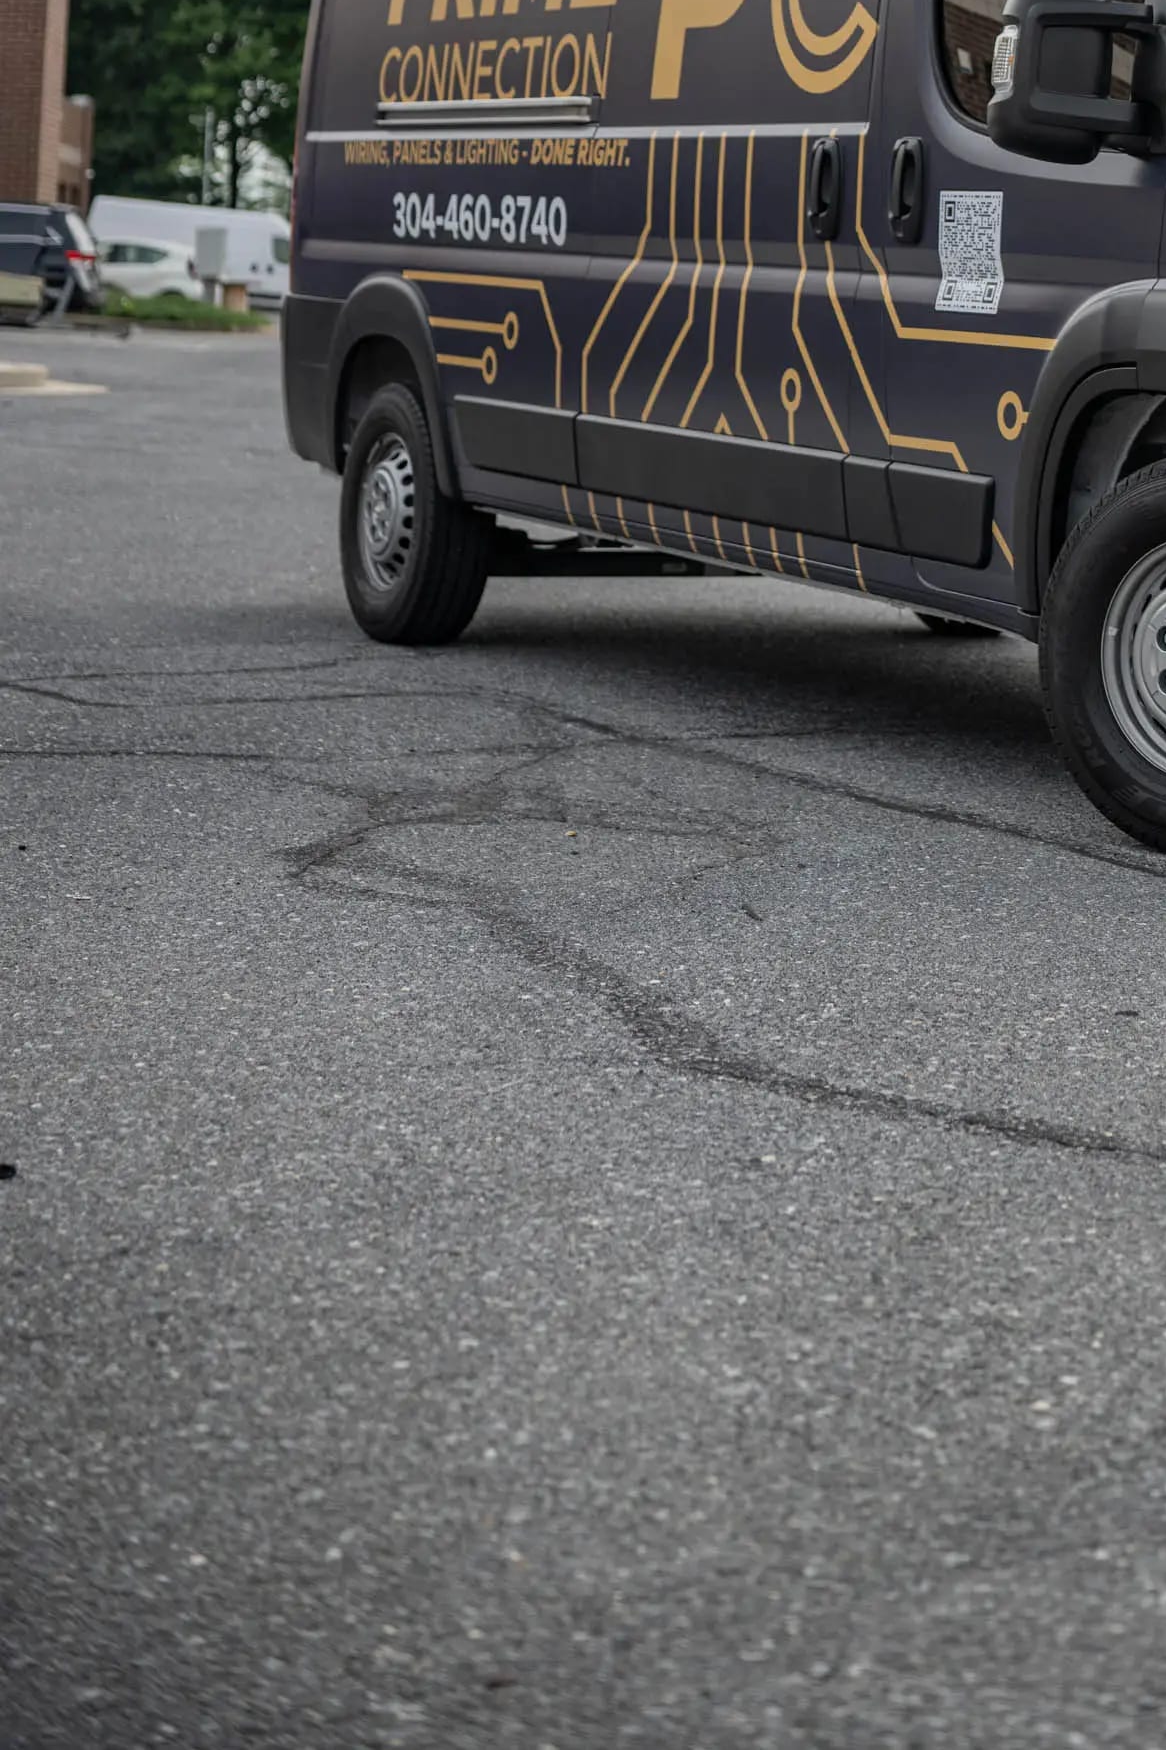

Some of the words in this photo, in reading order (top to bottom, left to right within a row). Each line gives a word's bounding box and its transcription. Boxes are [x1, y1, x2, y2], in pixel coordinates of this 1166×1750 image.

[378, 32, 612, 102] CONNECTION
[344, 139, 391, 168] WIRING,
[393, 139, 441, 165] PANELS
[444, 140, 452, 164] &
[455, 138, 519, 165] LIGHTING
[530, 138, 575, 166] DONE
[577, 137, 630, 167] RIGHT.
[392, 192, 567, 246] 304-460-8740
